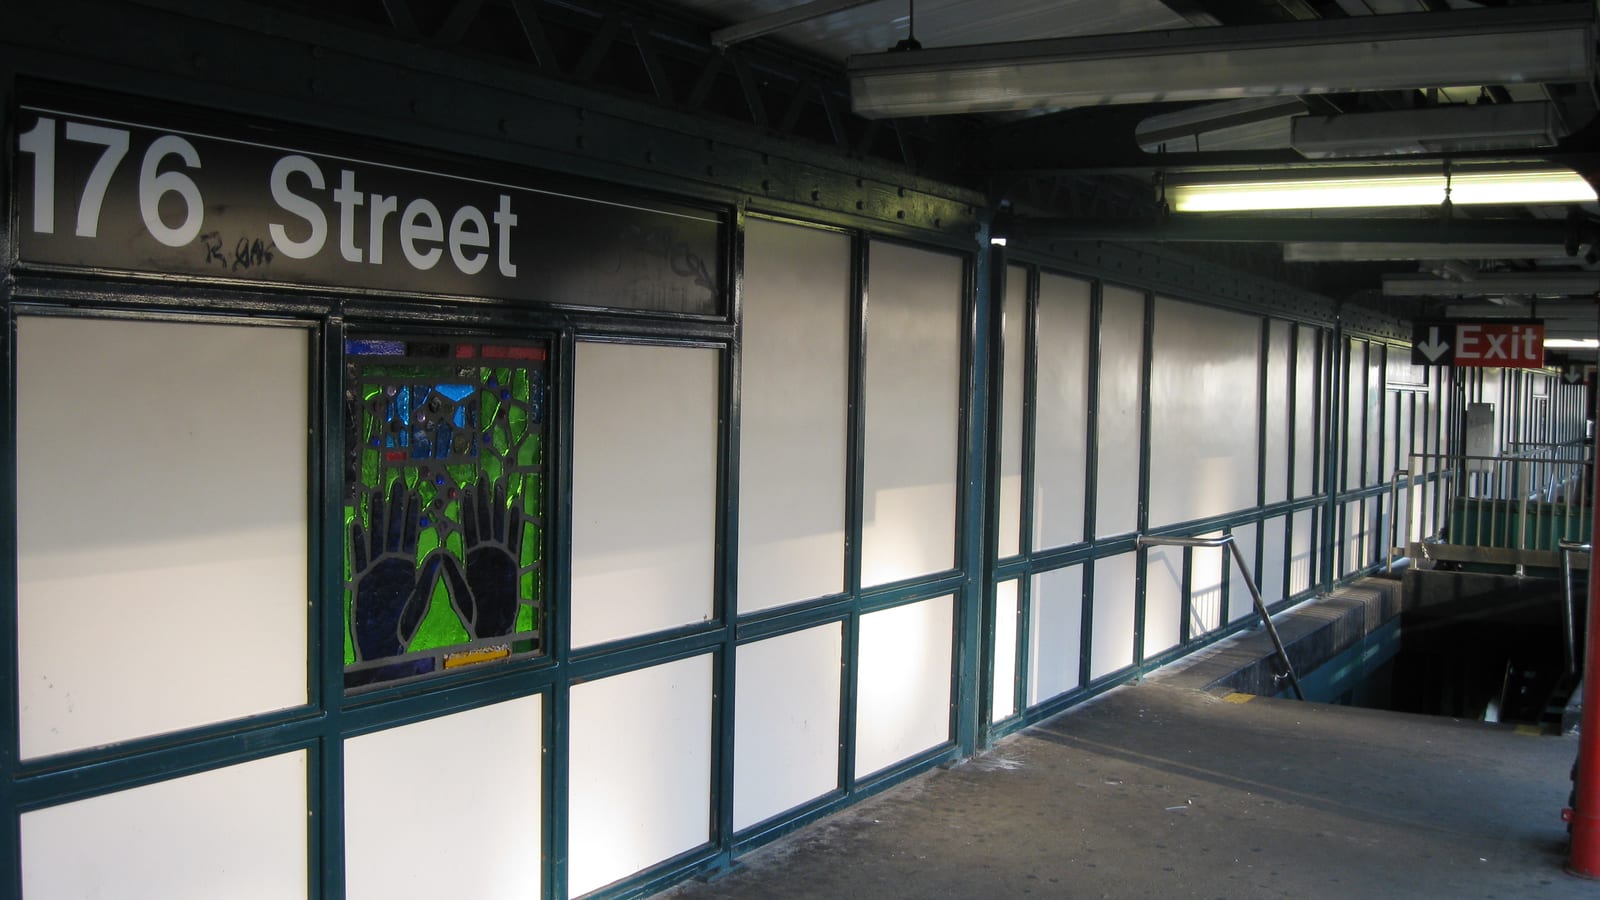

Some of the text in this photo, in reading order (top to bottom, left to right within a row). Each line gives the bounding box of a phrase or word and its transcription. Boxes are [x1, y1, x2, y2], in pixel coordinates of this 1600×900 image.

[19, 117, 204, 247] 176
[269, 155, 518, 278] Street
[1456, 325, 1537, 359] Exit
